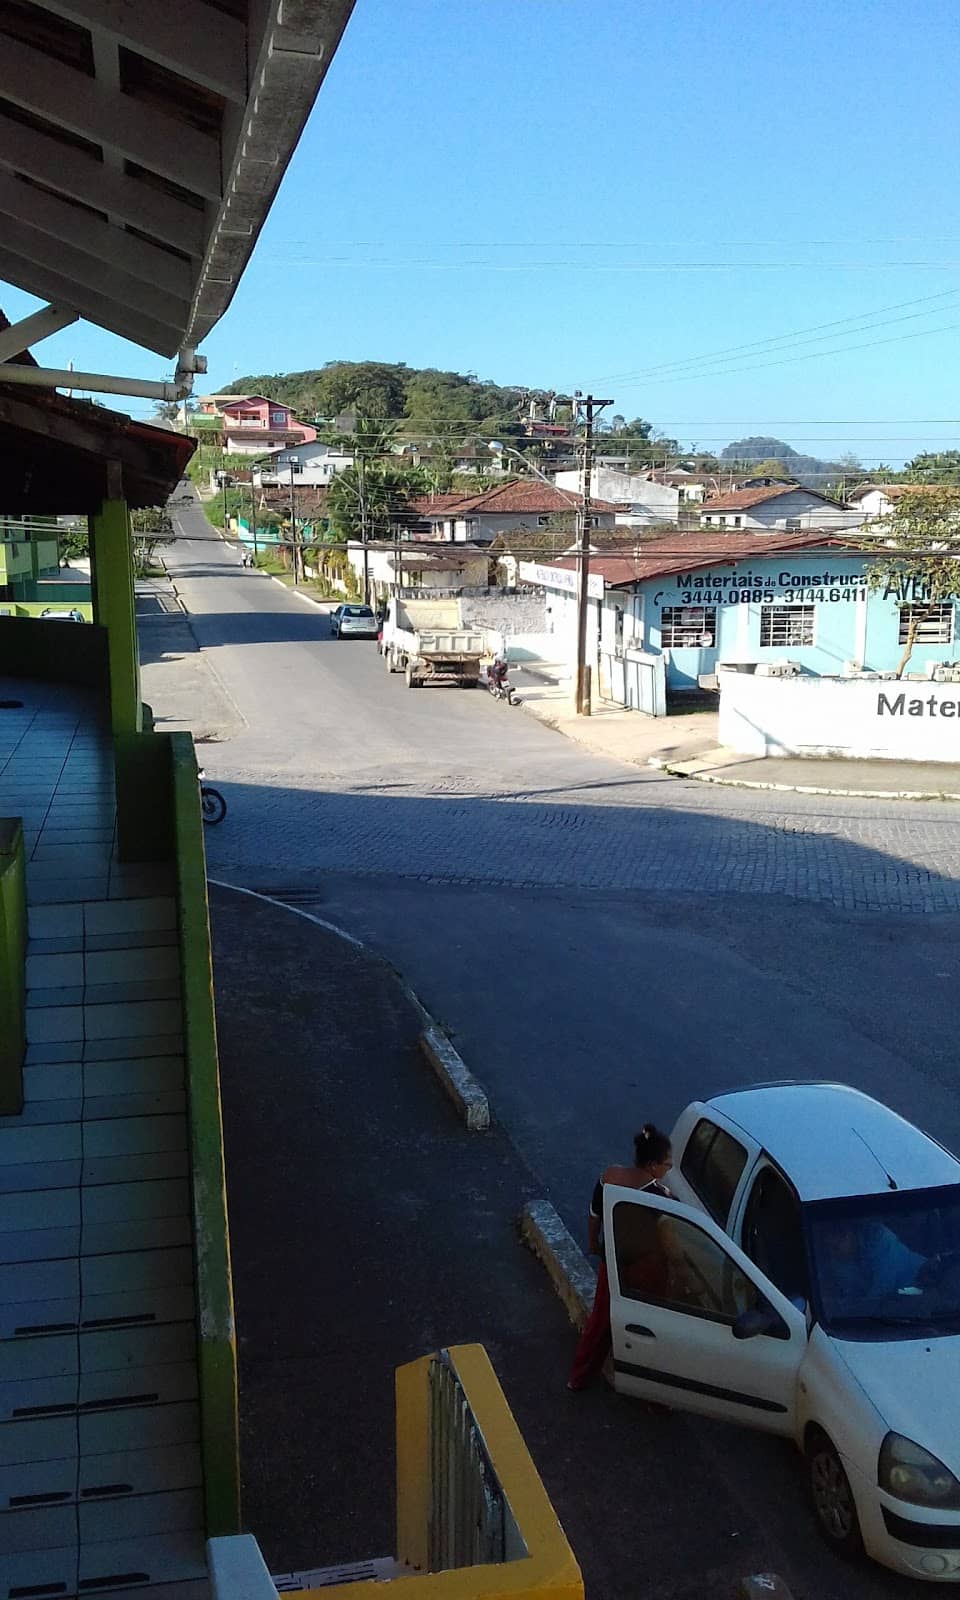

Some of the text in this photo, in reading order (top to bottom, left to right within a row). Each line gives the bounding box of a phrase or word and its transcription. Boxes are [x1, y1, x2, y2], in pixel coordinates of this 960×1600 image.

[677, 571, 763, 588] Materiais
[681, 589, 775, 604] 3444.0885
[784, 588, 866, 602] 3444.6411
[877, 692, 960, 718] Mate
